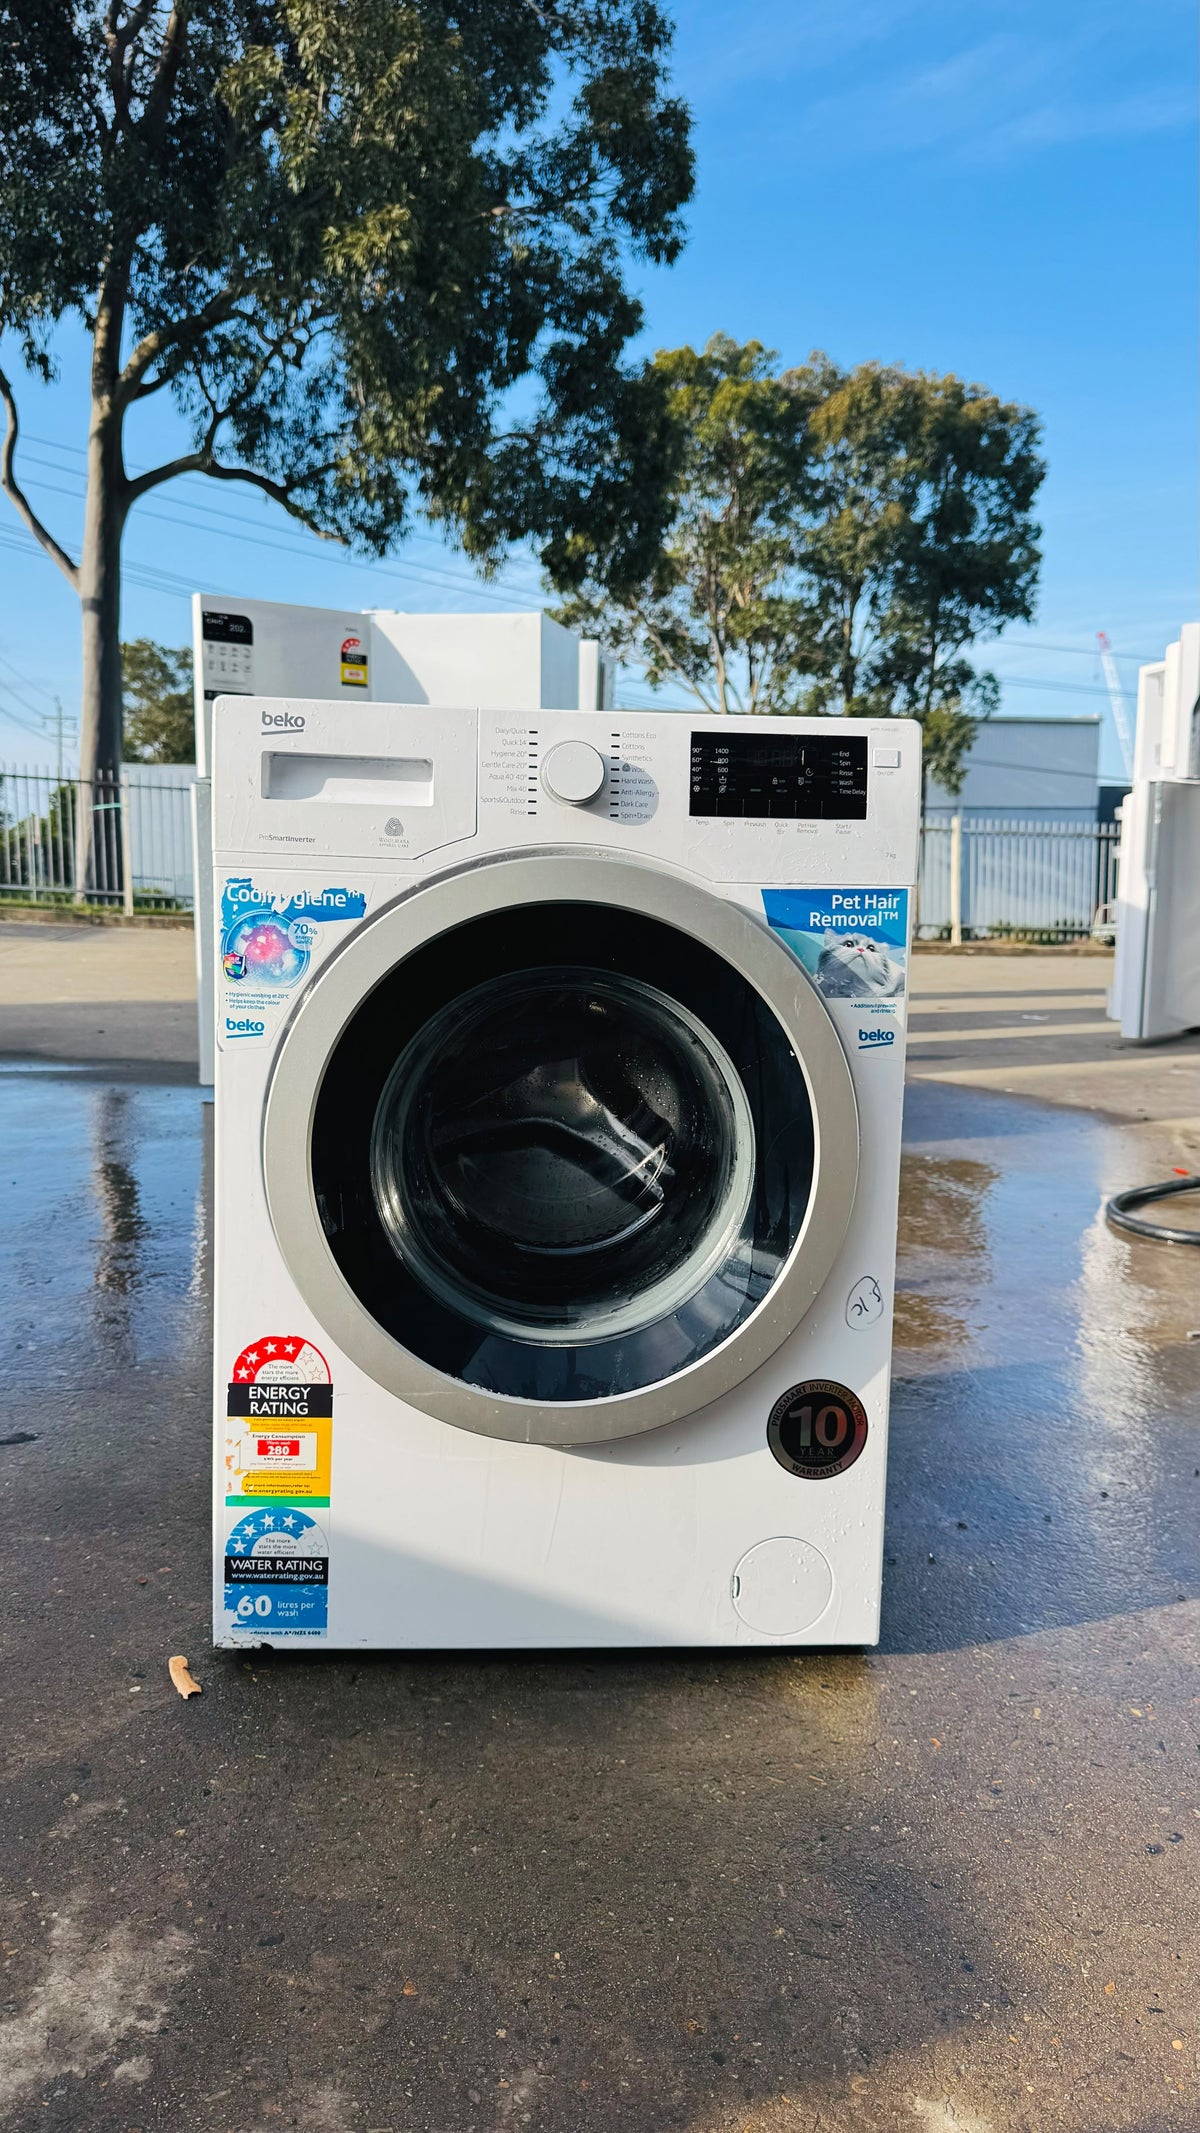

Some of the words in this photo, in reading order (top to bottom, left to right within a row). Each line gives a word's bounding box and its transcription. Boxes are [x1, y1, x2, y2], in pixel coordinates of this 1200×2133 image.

[261, 711, 306, 728] beko
[502, 739, 518, 747] Quick
[490, 750, 515, 758] Hygiene
[851, 788, 866, 797] Delay
[620, 800, 634, 808] Dark
[634, 801, 649, 809] Care
[510, 808, 527, 816] Rinse
[258, 833, 317, 844] ProSmartInverter
[831, 894, 861, 910] Pet
[864, 894, 900, 910] Hair
[226, 1017, 265, 1032] beko
[858, 1028, 895, 1041] beko
[248, 1386, 311, 1400] ENERGY
[250, 1401, 309, 1415] RATING
[809, 1383, 847, 1400] INVERTER
[847, 1398, 865, 1426] MOTOR
[788, 1405, 848, 1447] 10
[267, 1445, 290, 1455] 280
[800, 1447, 834, 1456] YEAR
[791, 1461, 843, 1477] WARRANTY
[230, 1559, 273, 1571] WATER
[276, 1560, 323, 1571] RATING
[231, 1572, 325, 1581] www.waterrating.gov.au
[237, 1594, 272, 1617] 60
[277, 1600, 299, 1609] litres
[300, 1601, 316, 1610] per
[277, 1609, 299, 1617] wash
